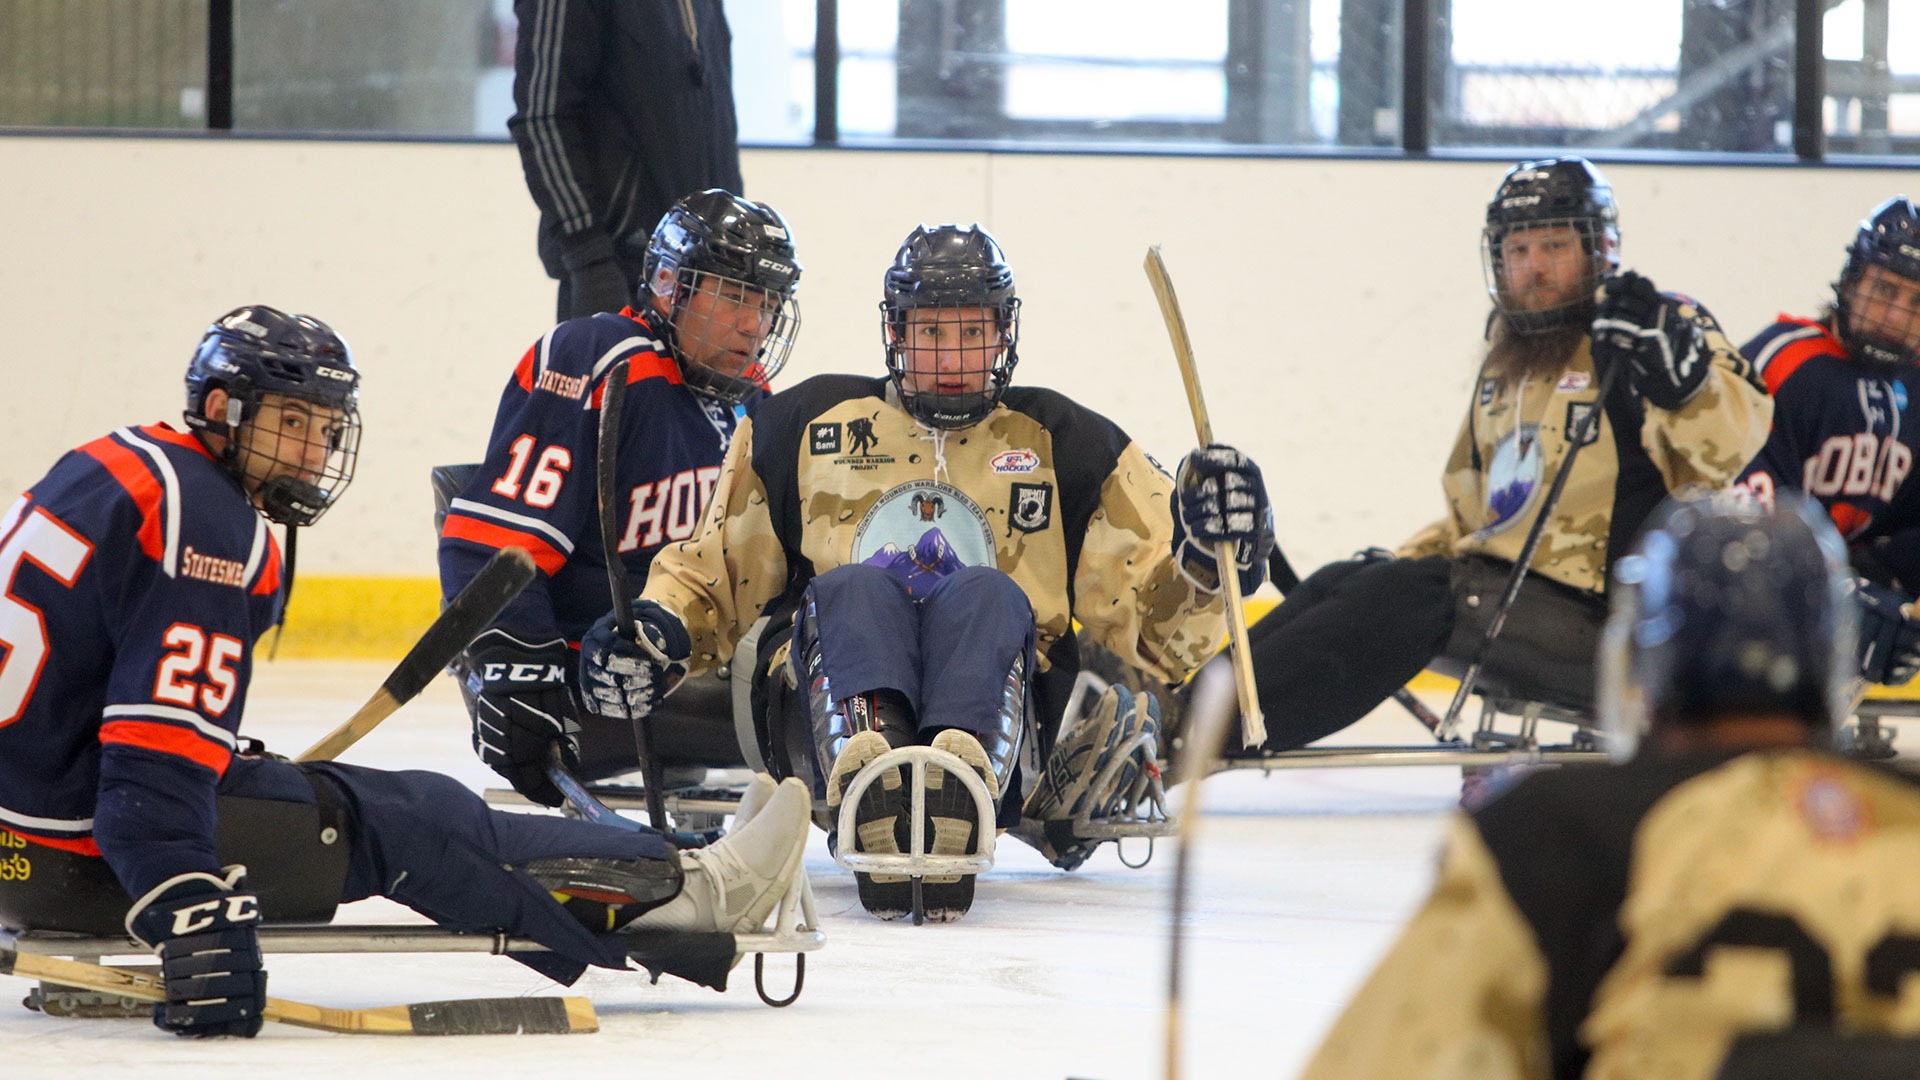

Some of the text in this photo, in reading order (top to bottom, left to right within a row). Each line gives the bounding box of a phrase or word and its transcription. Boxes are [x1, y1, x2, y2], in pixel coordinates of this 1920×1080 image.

[758, 258, 793, 274] CCM
[315, 366, 355, 382] CCM
[816, 427, 834, 438] #1
[491, 433, 573, 509] 16
[856, 504, 880, 537] MOUNTAIN
[879, 483, 913, 504] WOUNDED
[969, 503, 984, 521] TEAM
[182, 545, 246, 588] STATESME
[152, 621, 244, 718] 25
[484, 663, 565, 684] CCM
[171, 895, 258, 936] CC
